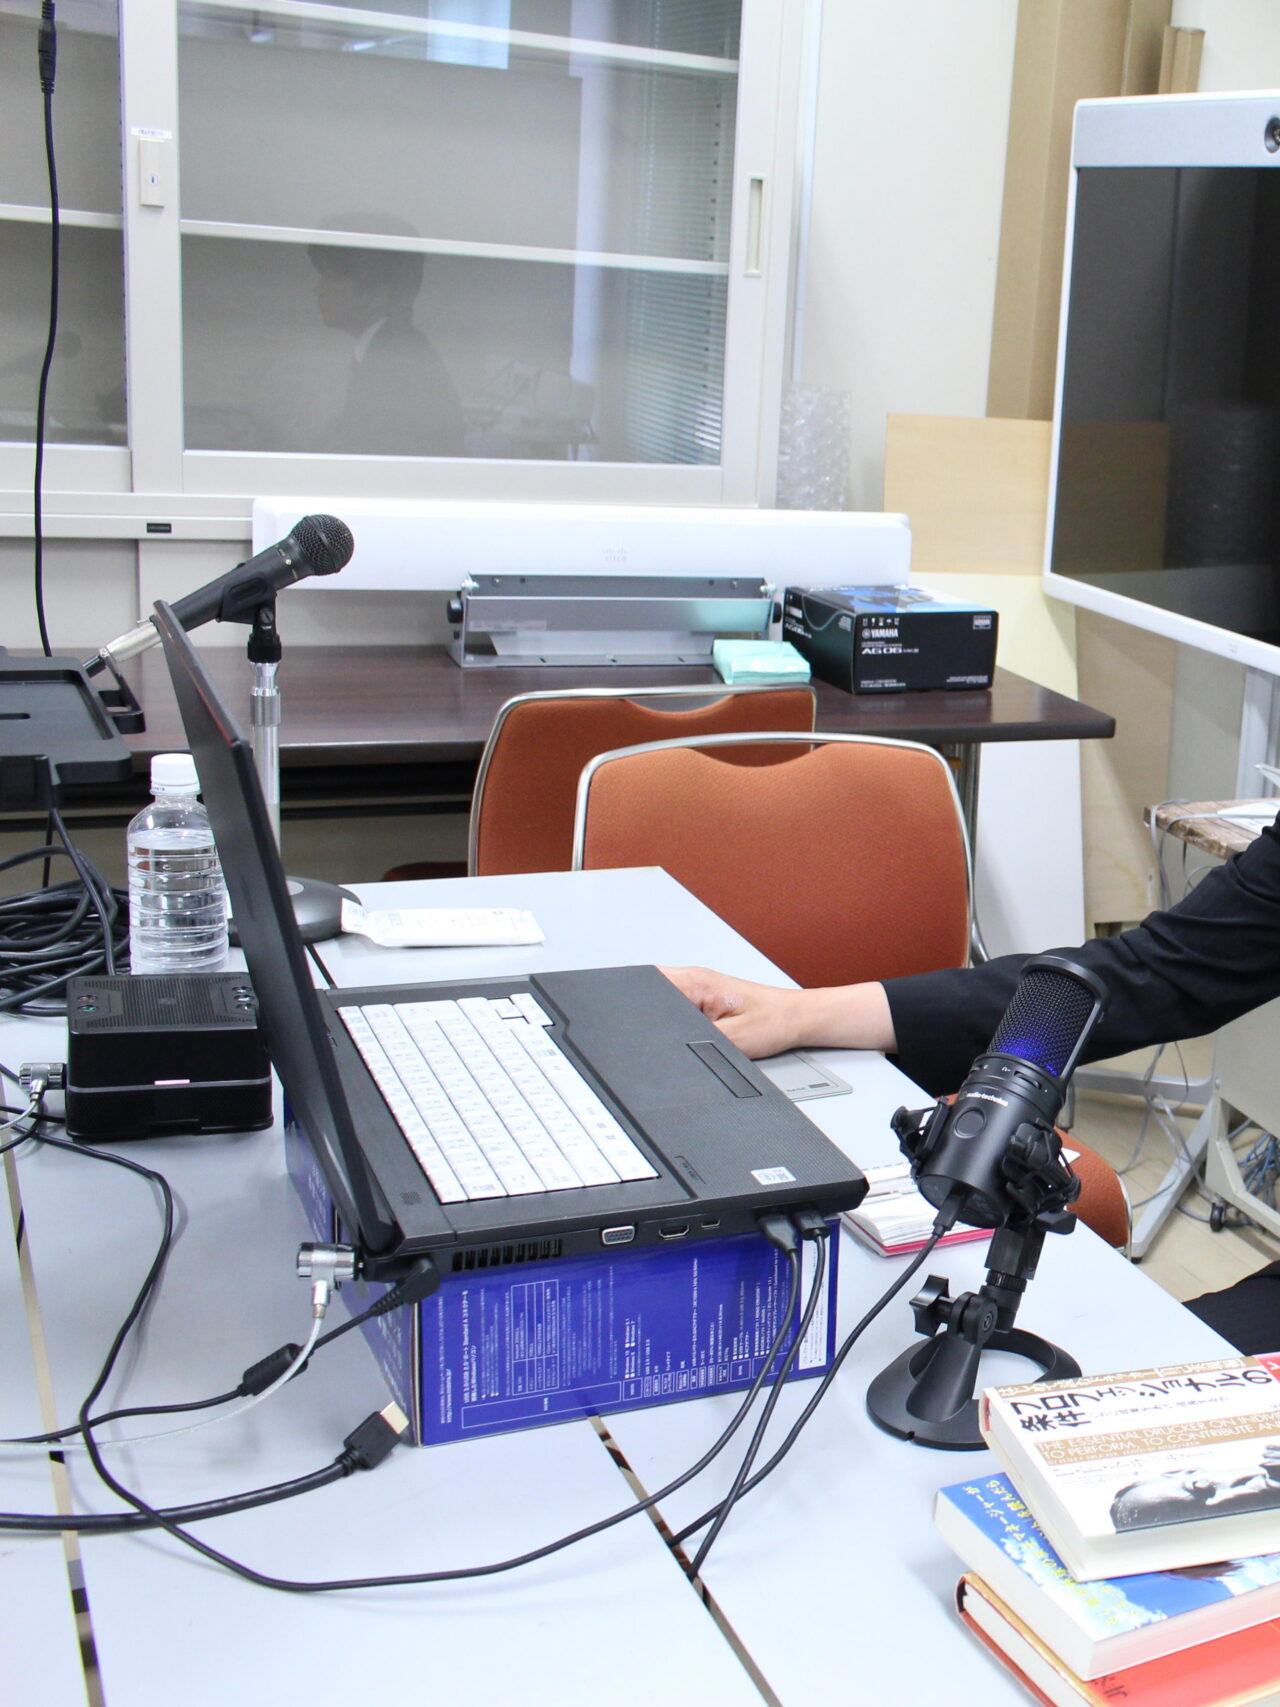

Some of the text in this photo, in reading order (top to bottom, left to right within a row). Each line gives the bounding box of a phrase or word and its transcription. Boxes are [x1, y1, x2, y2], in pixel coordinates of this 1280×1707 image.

[871, 628, 899, 639] YAMAHA
[1002, 1368, 1276, 1415] プロフェッショナルの
[1015, 1408, 1093, 1433] 条件
[1035, 1440, 1067, 1451] THE
[1066, 1430, 1140, 1446] ESSENTIAL
[1140, 1421, 1208, 1437] DRUCKER
[1207, 1417, 1238, 1428] ON
[1041, 1449, 1067, 1459] TO
[1141, 1436, 1166, 1446] TO
[1164, 1424, 1256, 1443] CONTRIBUTE
